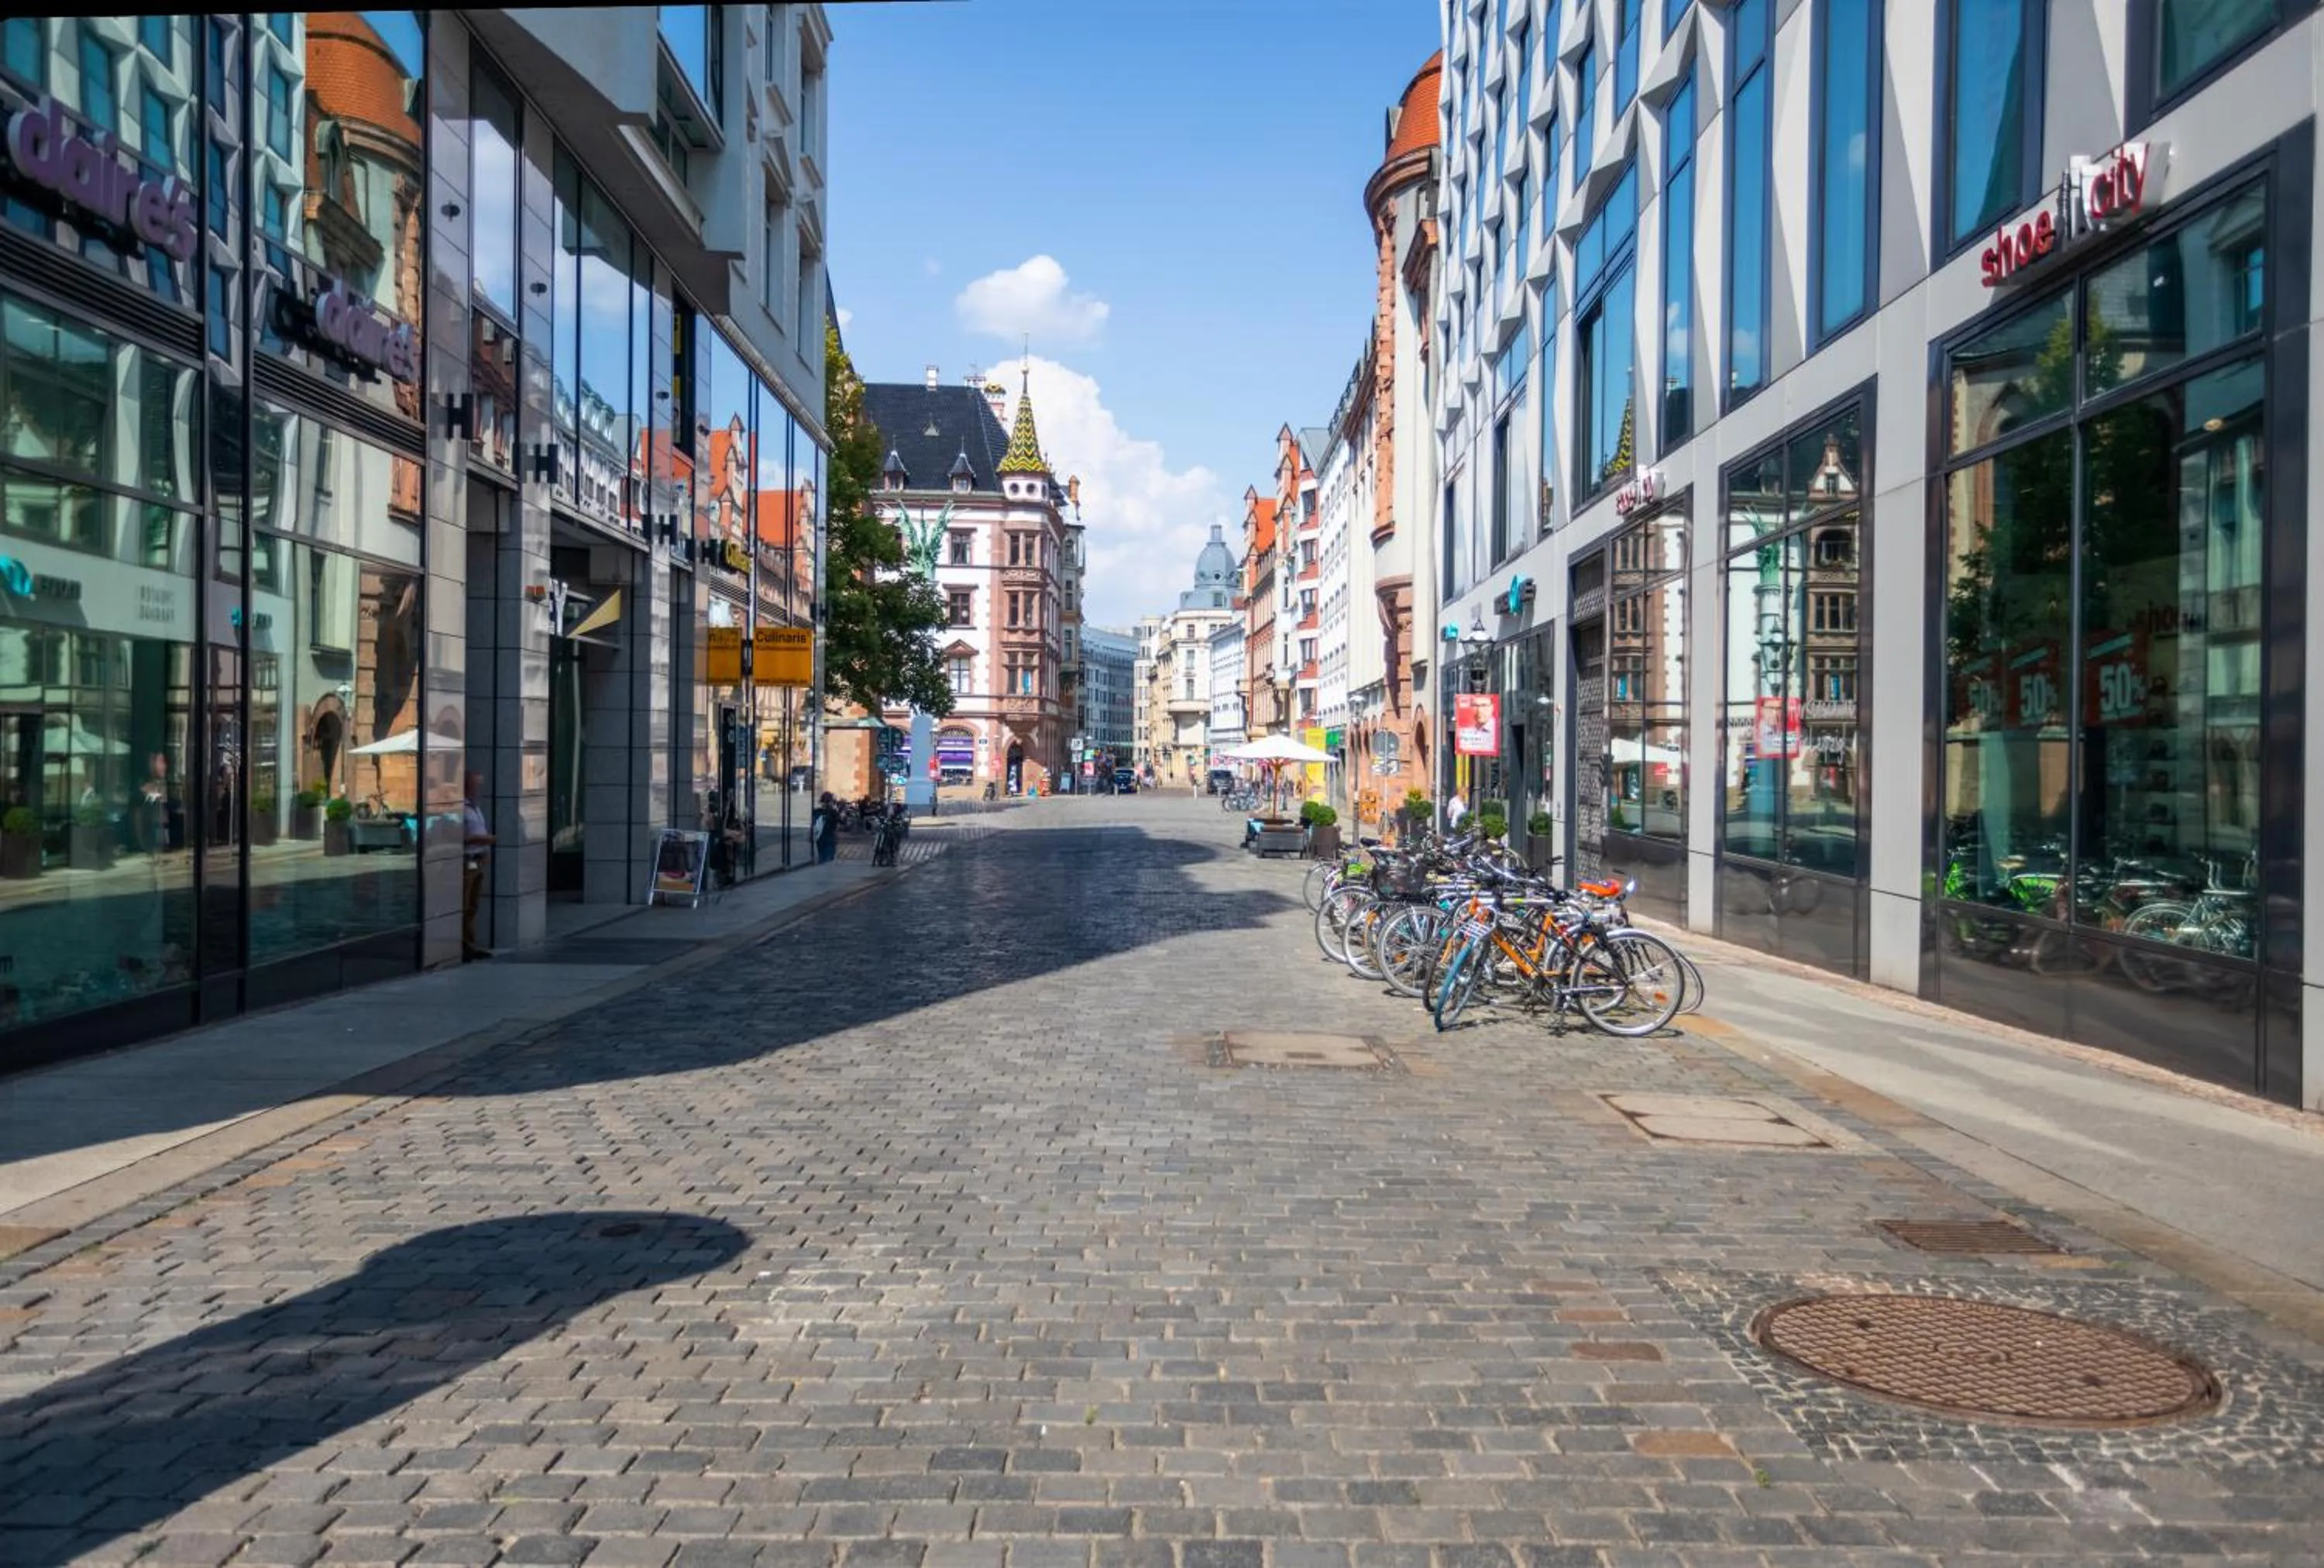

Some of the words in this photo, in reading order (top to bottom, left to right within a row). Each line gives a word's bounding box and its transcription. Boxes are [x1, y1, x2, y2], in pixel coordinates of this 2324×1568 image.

[1982, 211, 2056, 287] shoe
[2090, 143, 2150, 218] city
[755, 631, 806, 645] Culinaris
[2020, 672, 2058, 718] 50%
[2099, 662, 2147, 714] 50%
